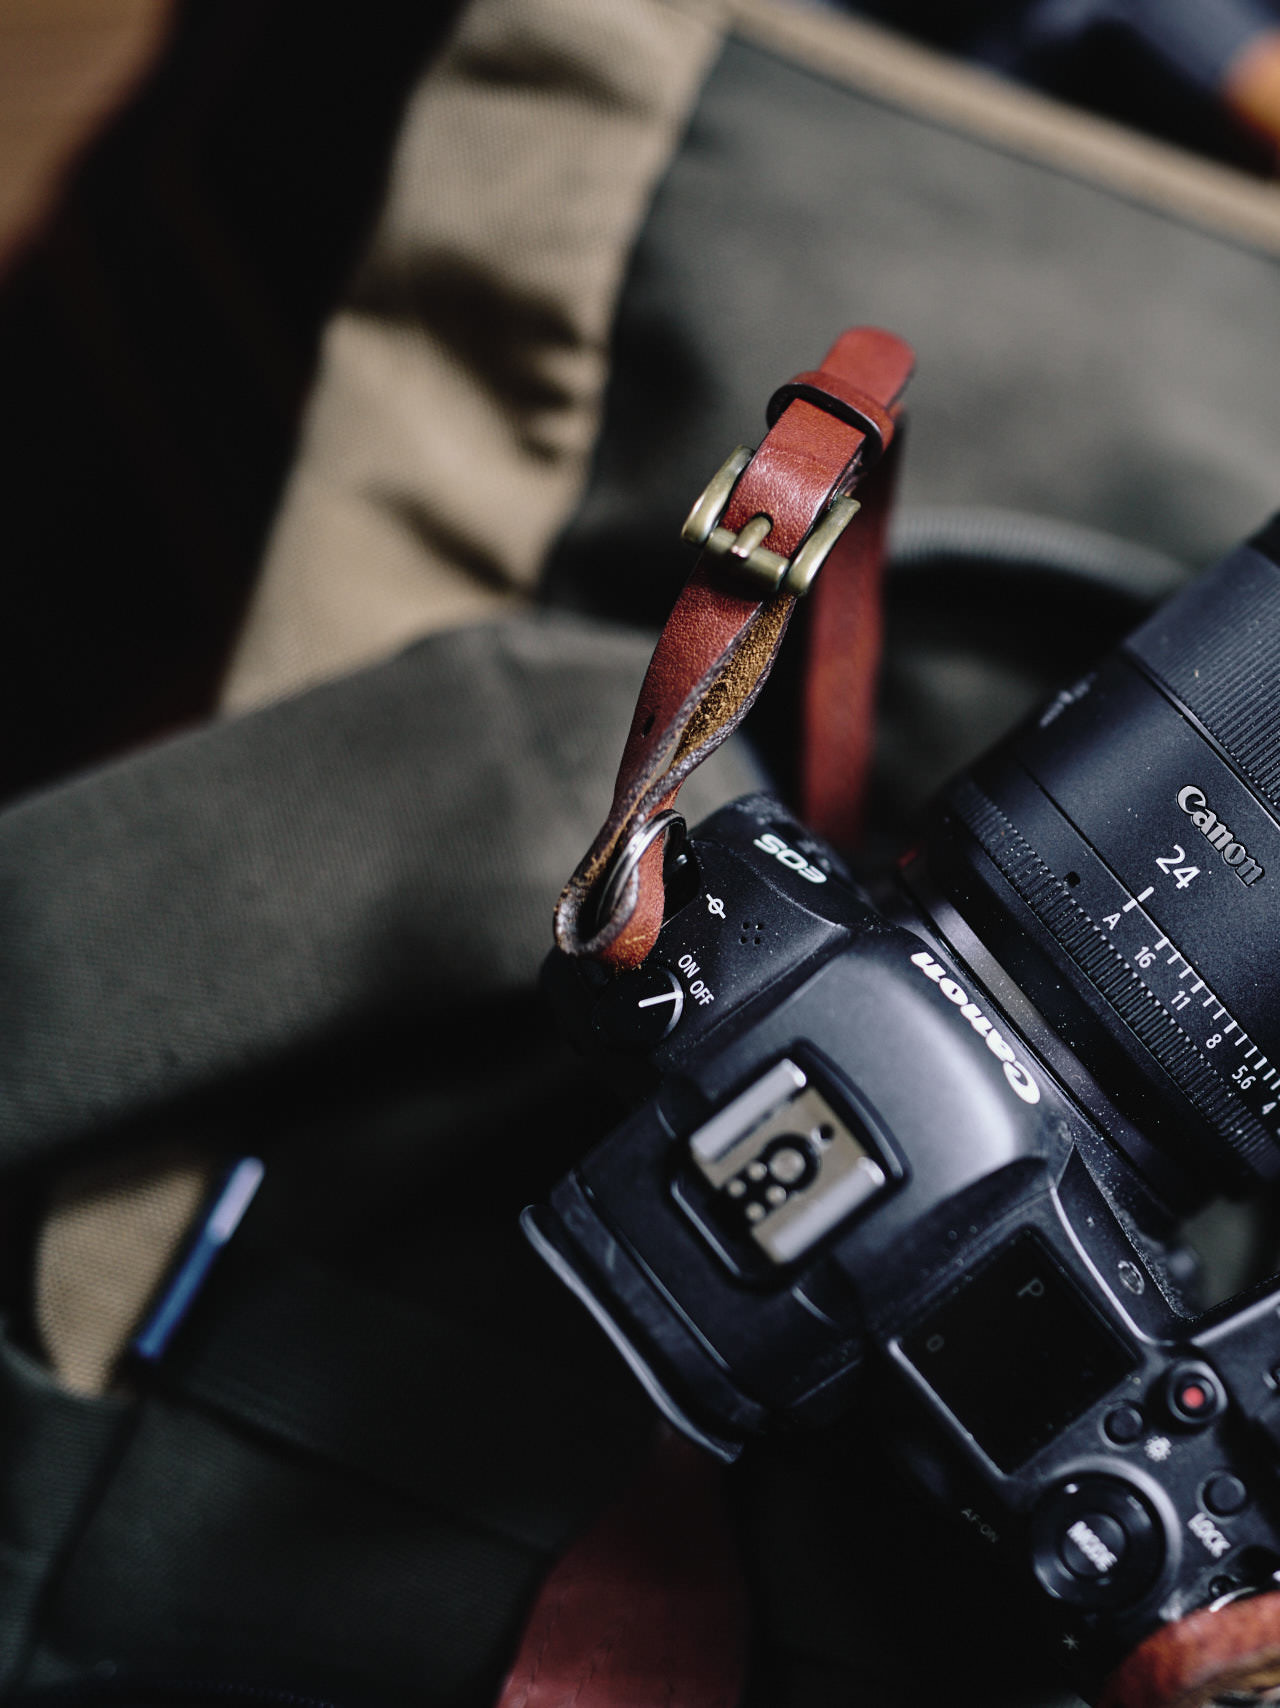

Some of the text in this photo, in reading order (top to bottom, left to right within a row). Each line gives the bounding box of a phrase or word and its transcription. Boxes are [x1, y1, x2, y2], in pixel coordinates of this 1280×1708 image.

[753, 833, 827, 884] EOS
[1176, 785, 1265, 886] Canon
[1155, 844, 1200, 890] 24
[677, 954, 715, 1006] ON OFF
[910, 951, 1041, 1105] Canon
[1102, 912, 1121, 930] A
[1134, 946, 1156, 969] 16
[1171, 990, 1191, 1011] 11
[1205, 1034, 1222, 1050] 8
[1231, 1064, 1257, 1090] 5.6
[1262, 1101, 1277, 1115] 4
[1188, 1511, 1231, 1557] LOCK
